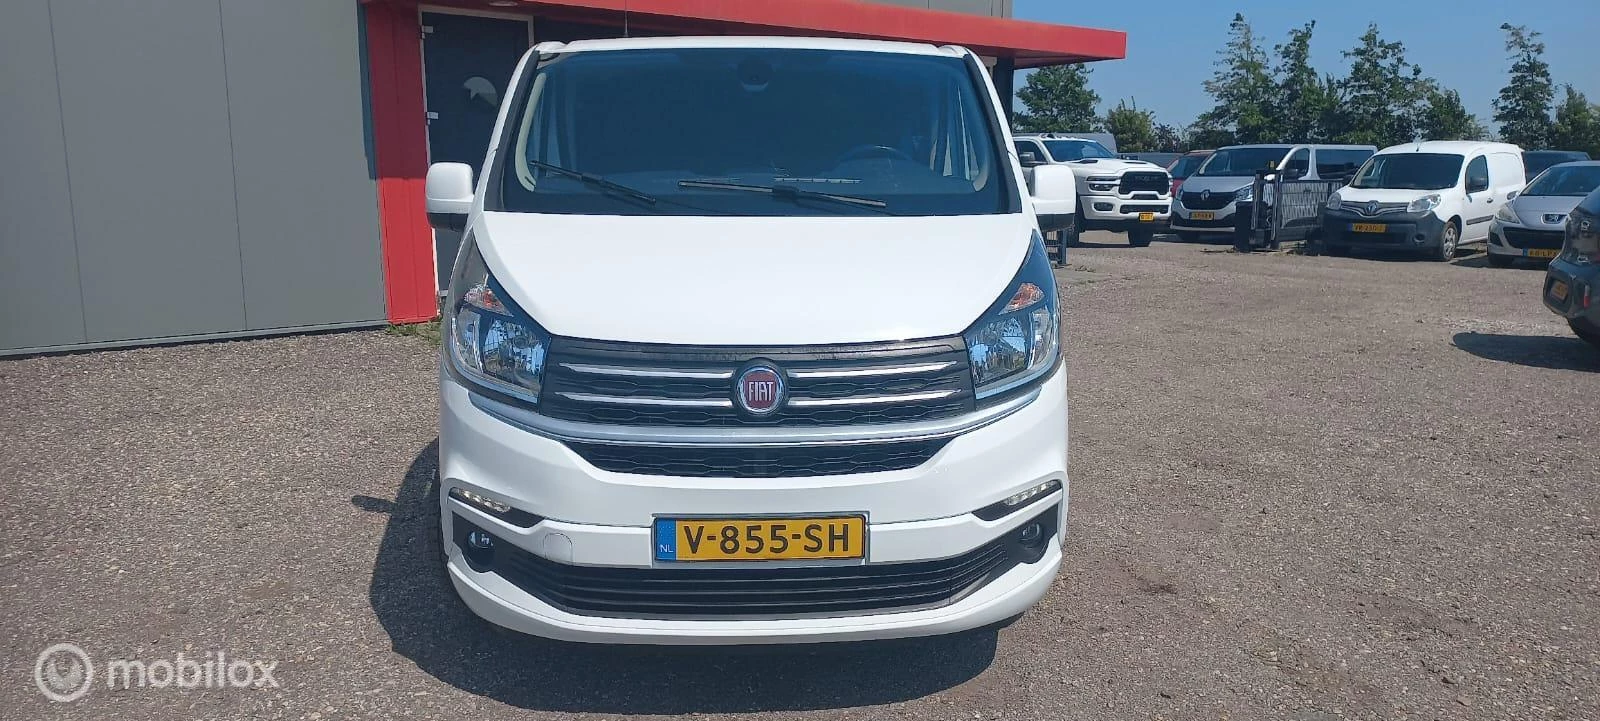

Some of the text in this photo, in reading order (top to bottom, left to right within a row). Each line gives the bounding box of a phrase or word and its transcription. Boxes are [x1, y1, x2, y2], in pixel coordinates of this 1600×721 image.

[748, 381, 774, 402] FIAT
[659, 523, 849, 554] NL V-855-SH
